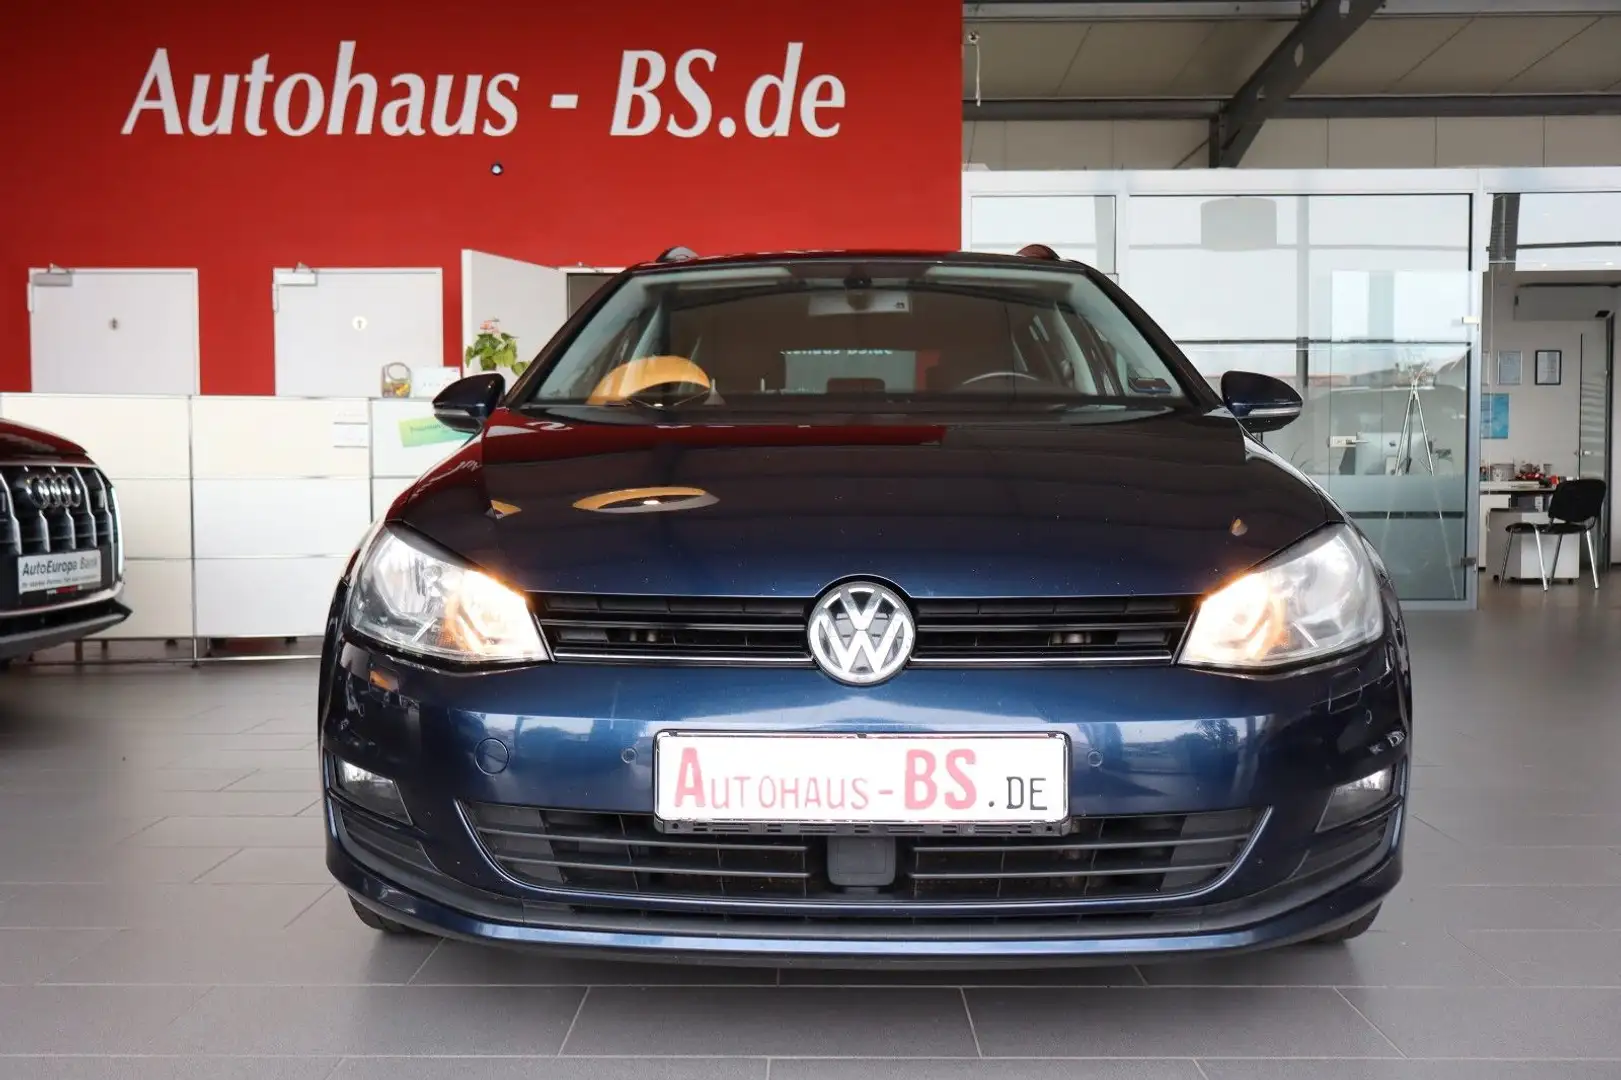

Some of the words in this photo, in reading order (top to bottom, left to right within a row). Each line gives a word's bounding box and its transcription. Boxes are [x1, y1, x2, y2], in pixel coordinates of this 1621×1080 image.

[121, 40, 520, 137] Autohaus
[550, 94, 579, 109] -
[609, 42, 846, 138] BS.de
[22, 559, 77, 576] AutoEuropa
